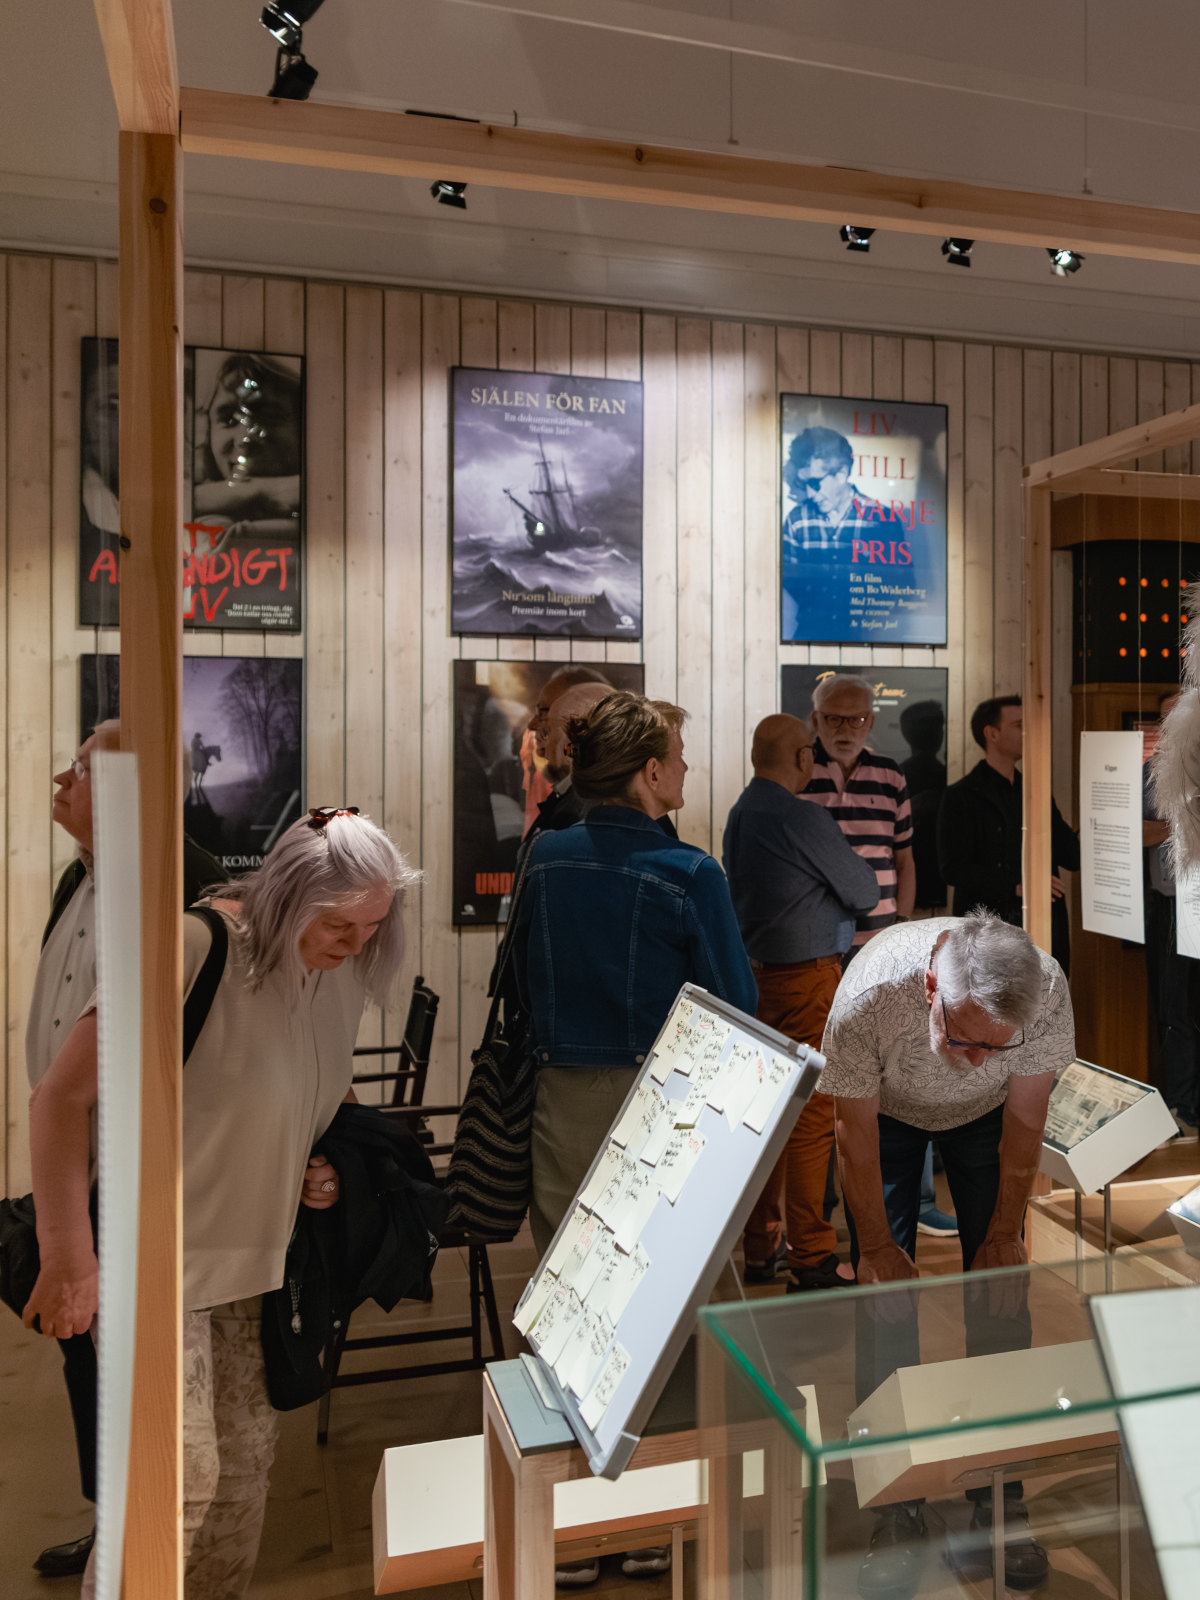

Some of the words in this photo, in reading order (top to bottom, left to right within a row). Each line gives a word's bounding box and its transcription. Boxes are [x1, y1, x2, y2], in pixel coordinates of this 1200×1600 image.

[471, 386, 540, 408] SJÄLEN
[546, 392, 585, 413] FÖR
[589, 397, 627, 415] FAN
[852, 411, 897, 435] LIV
[851, 454, 916, 480] TILL
[852, 497, 935, 530] VARJE
[183, 523, 225, 549] TT
[851, 539, 912, 566] PRIS
[849, 573, 862, 582] En
[864, 573, 882, 583] film
[867, 585, 879, 594] Bo
[183, 587, 229, 622] IV
[502, 590, 520, 601] Nu
[521, 593, 545, 602] som
[512, 605, 544, 615] Premiär
[546, 606, 567, 617] inom
[569, 607, 586, 617] kort
[222, 856, 266, 867] KOMM
[475, 872, 515, 894] UND
